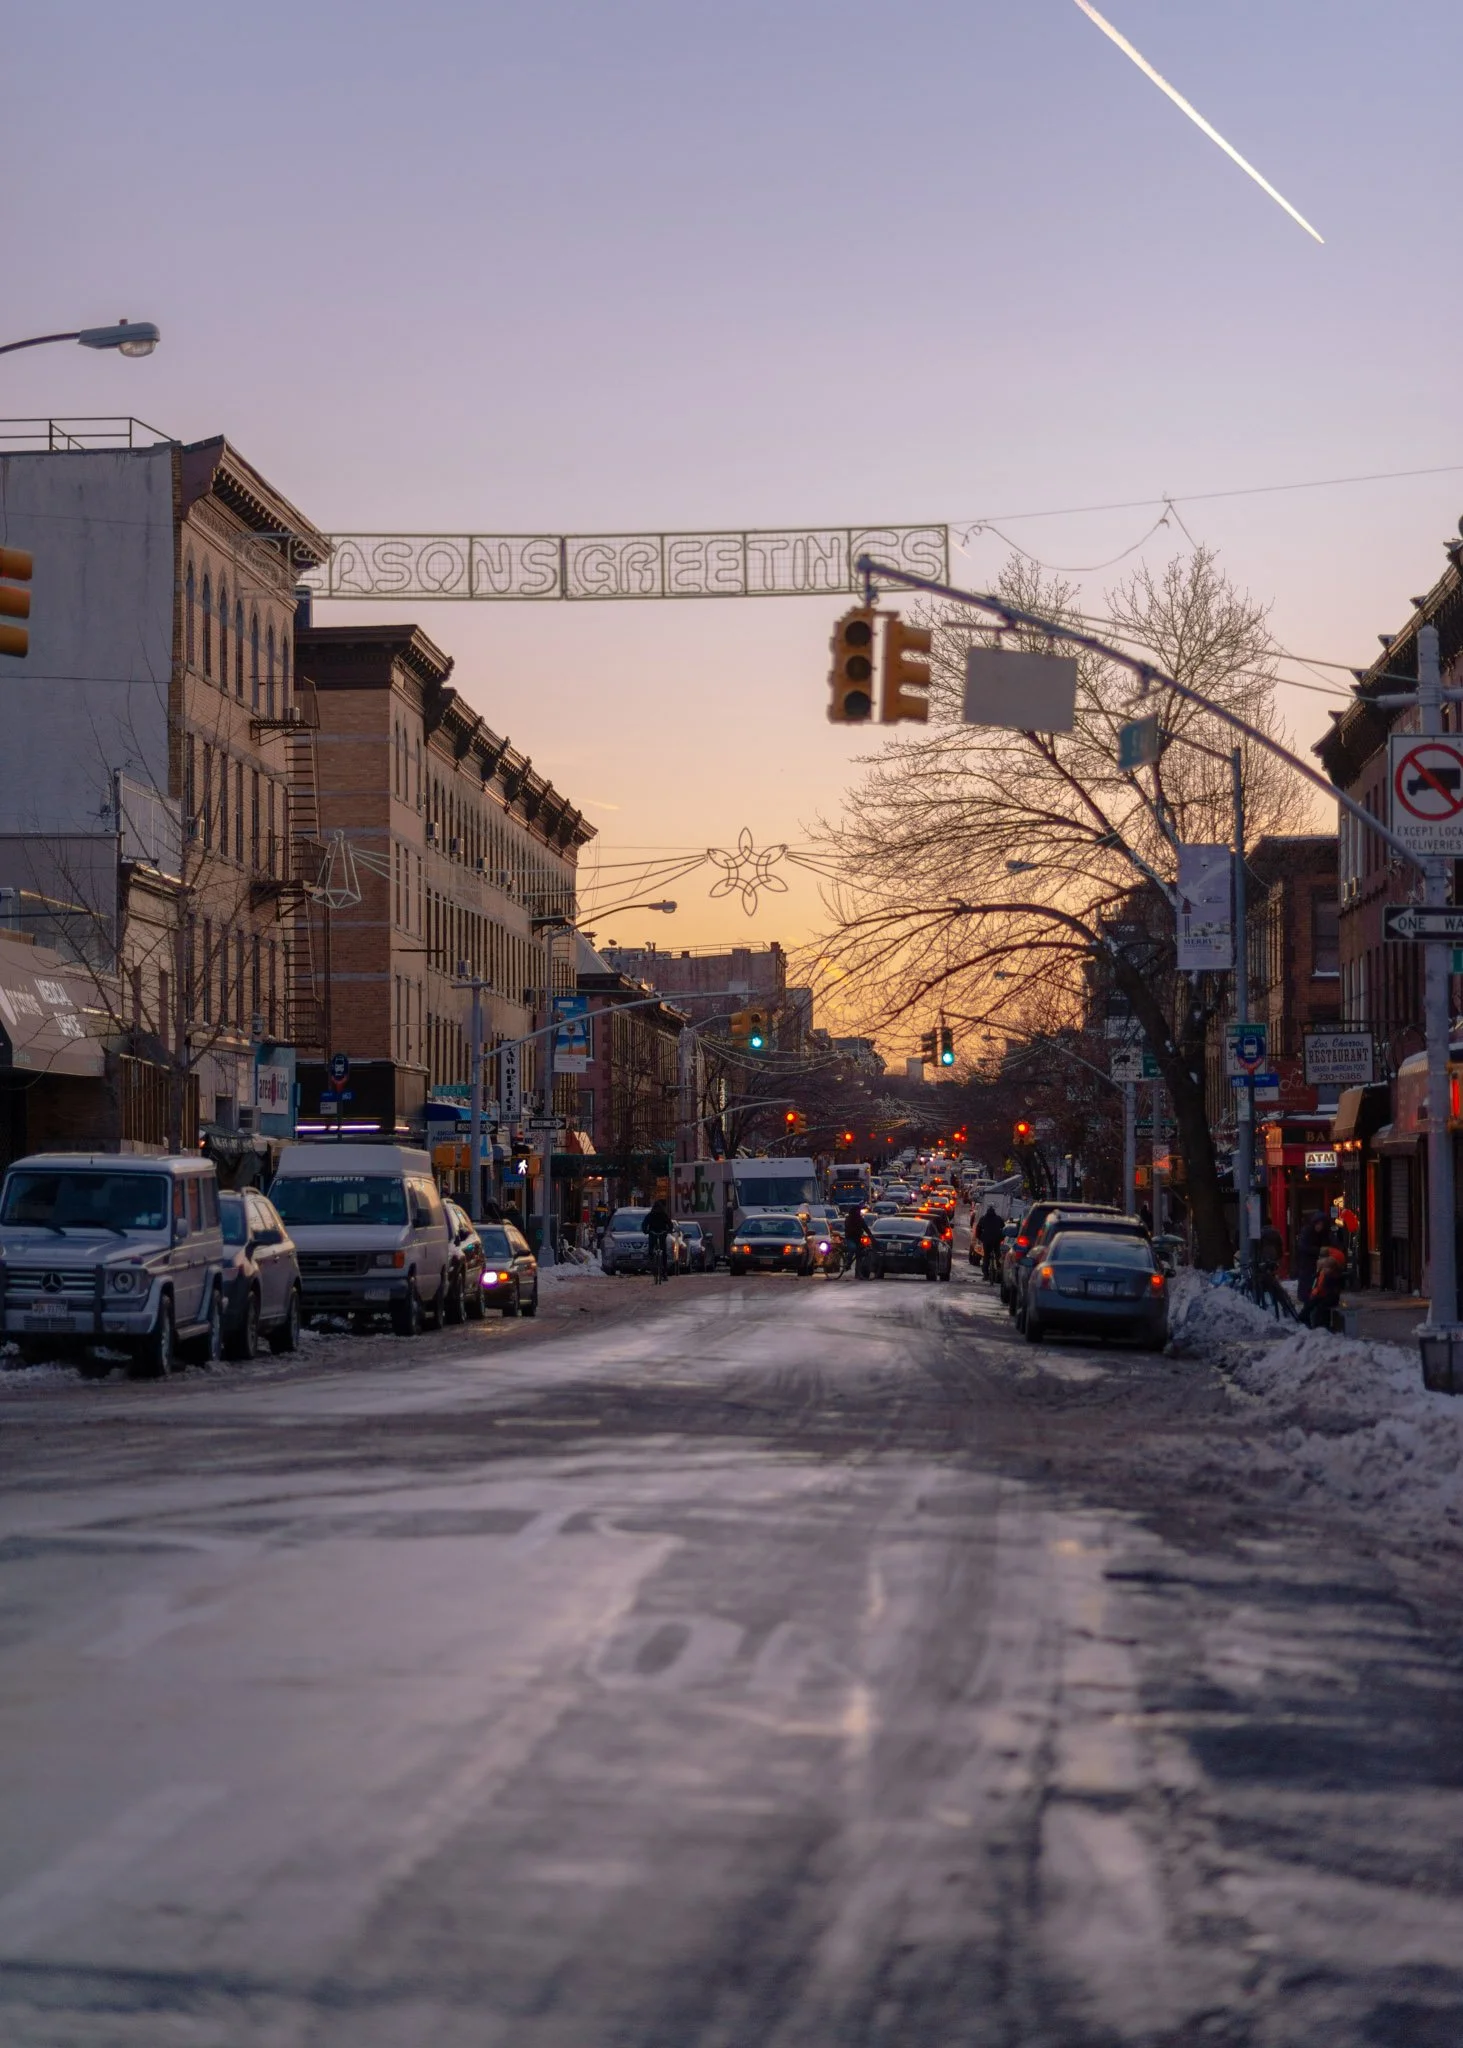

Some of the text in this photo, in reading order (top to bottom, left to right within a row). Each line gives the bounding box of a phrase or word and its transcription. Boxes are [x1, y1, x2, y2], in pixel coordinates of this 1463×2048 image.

[573, 528, 945, 594] GREETINGS
[1397, 826, 1463, 837] EXCEPT LOCA
[1405, 839, 1462, 850] DELIVERIES
[1398, 916, 1463, 931] ONE WA
[1308, 1048, 1369, 1063] RESTAURANT
[505, 1067, 516, 1112] OFFICE
[1306, 1131, 1326, 1142] BA
[1307, 1153, 1335, 1163] ATM
[675, 1166, 715, 1213] FedEx
